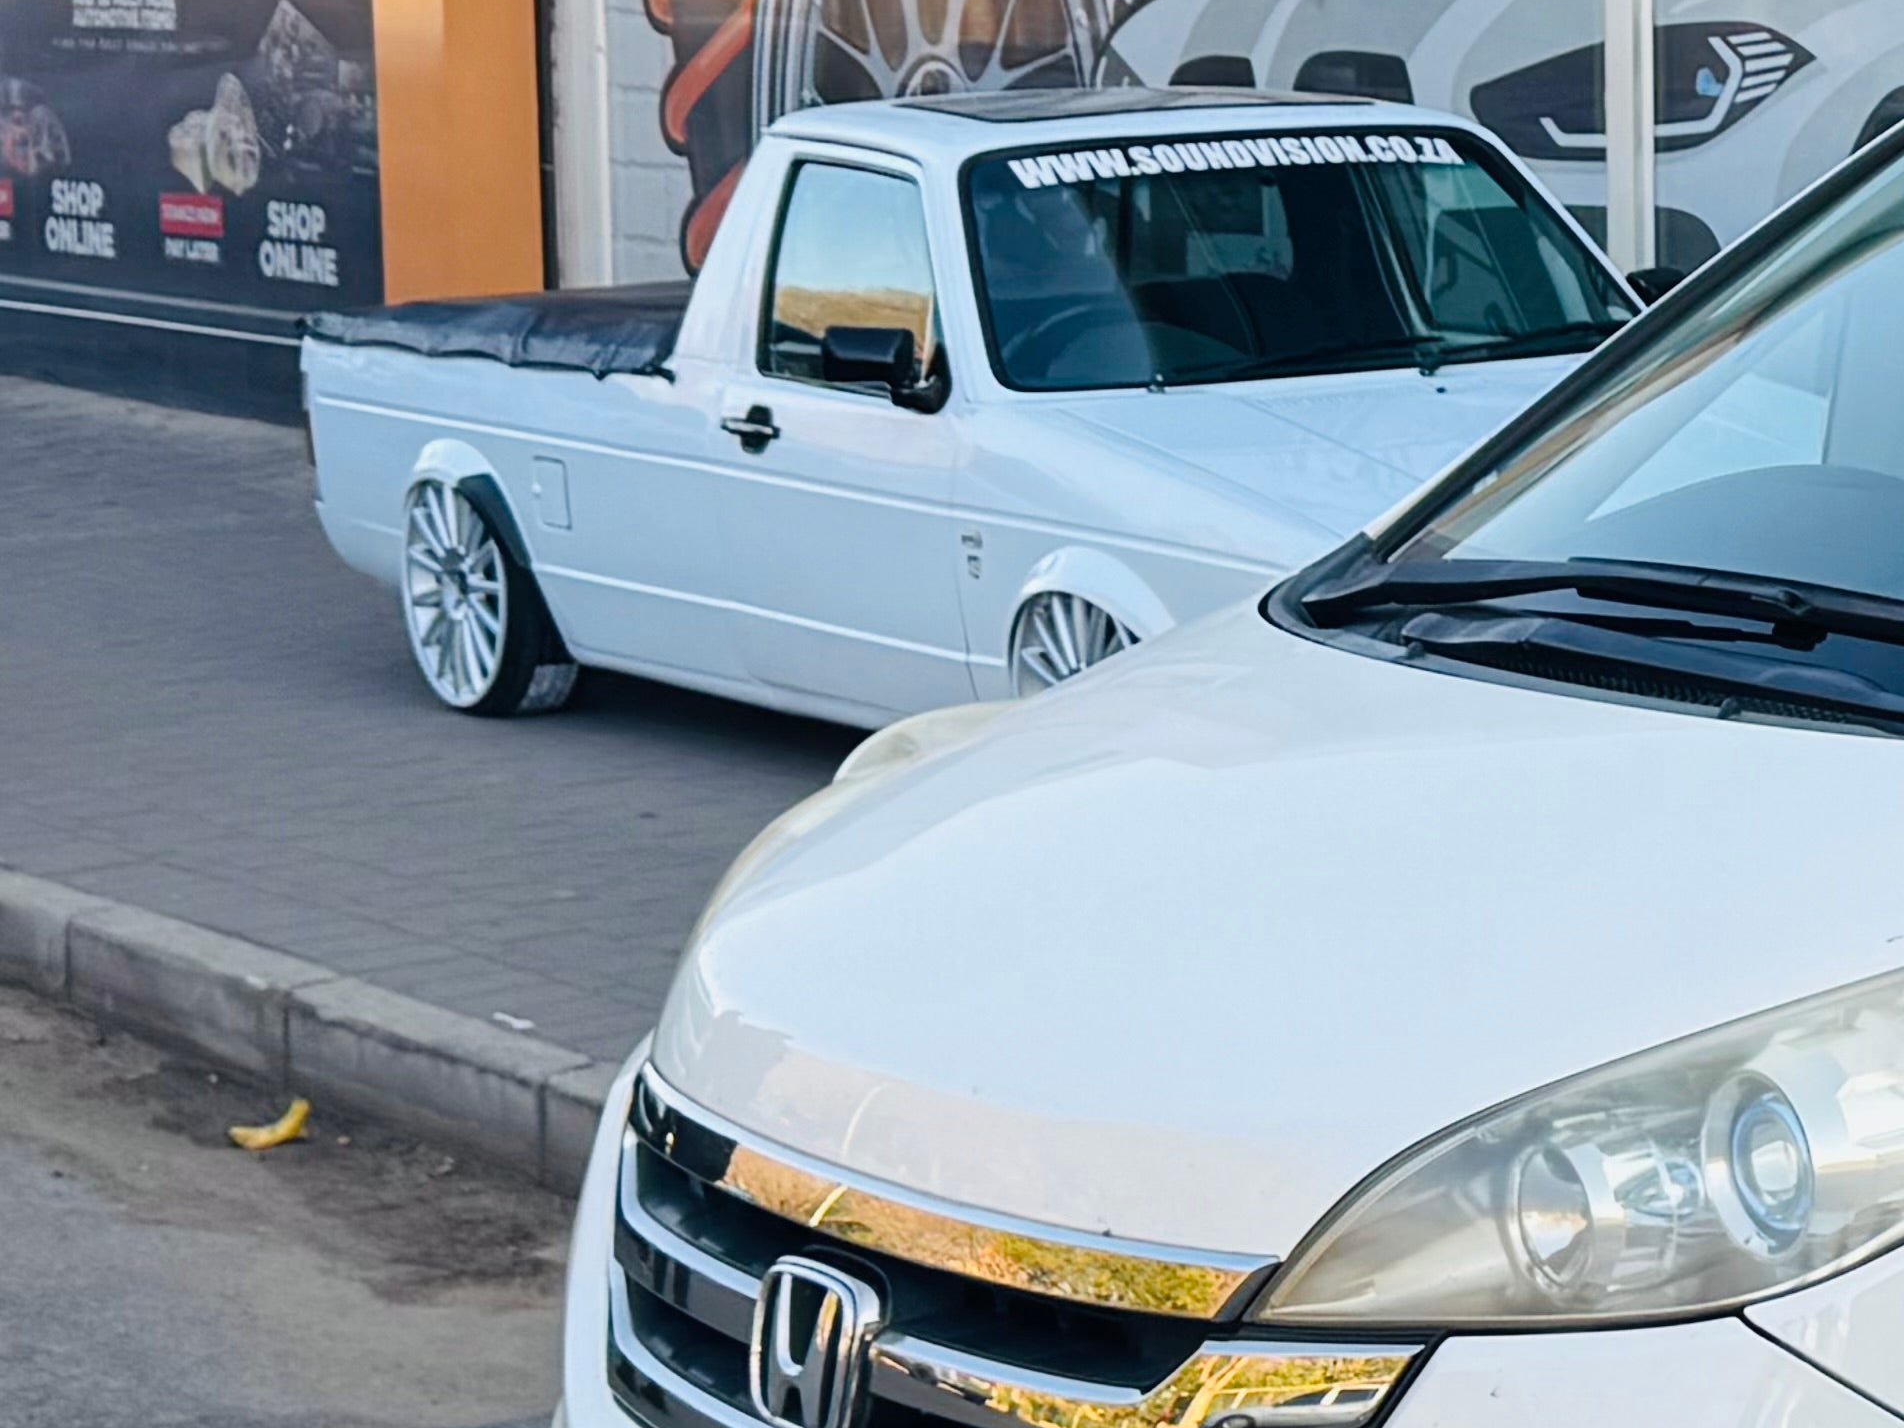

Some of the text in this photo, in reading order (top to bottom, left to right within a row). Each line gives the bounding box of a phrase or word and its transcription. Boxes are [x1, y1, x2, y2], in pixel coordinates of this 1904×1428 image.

[1008, 136, 1466, 190] WWW.SOUNDVISION.CO.ZA
[51, 178, 104, 218] SHOP
[45, 216, 116, 259] ONLINE
[267, 200, 326, 243] SHOP
[259, 241, 339, 286] ONLINE
